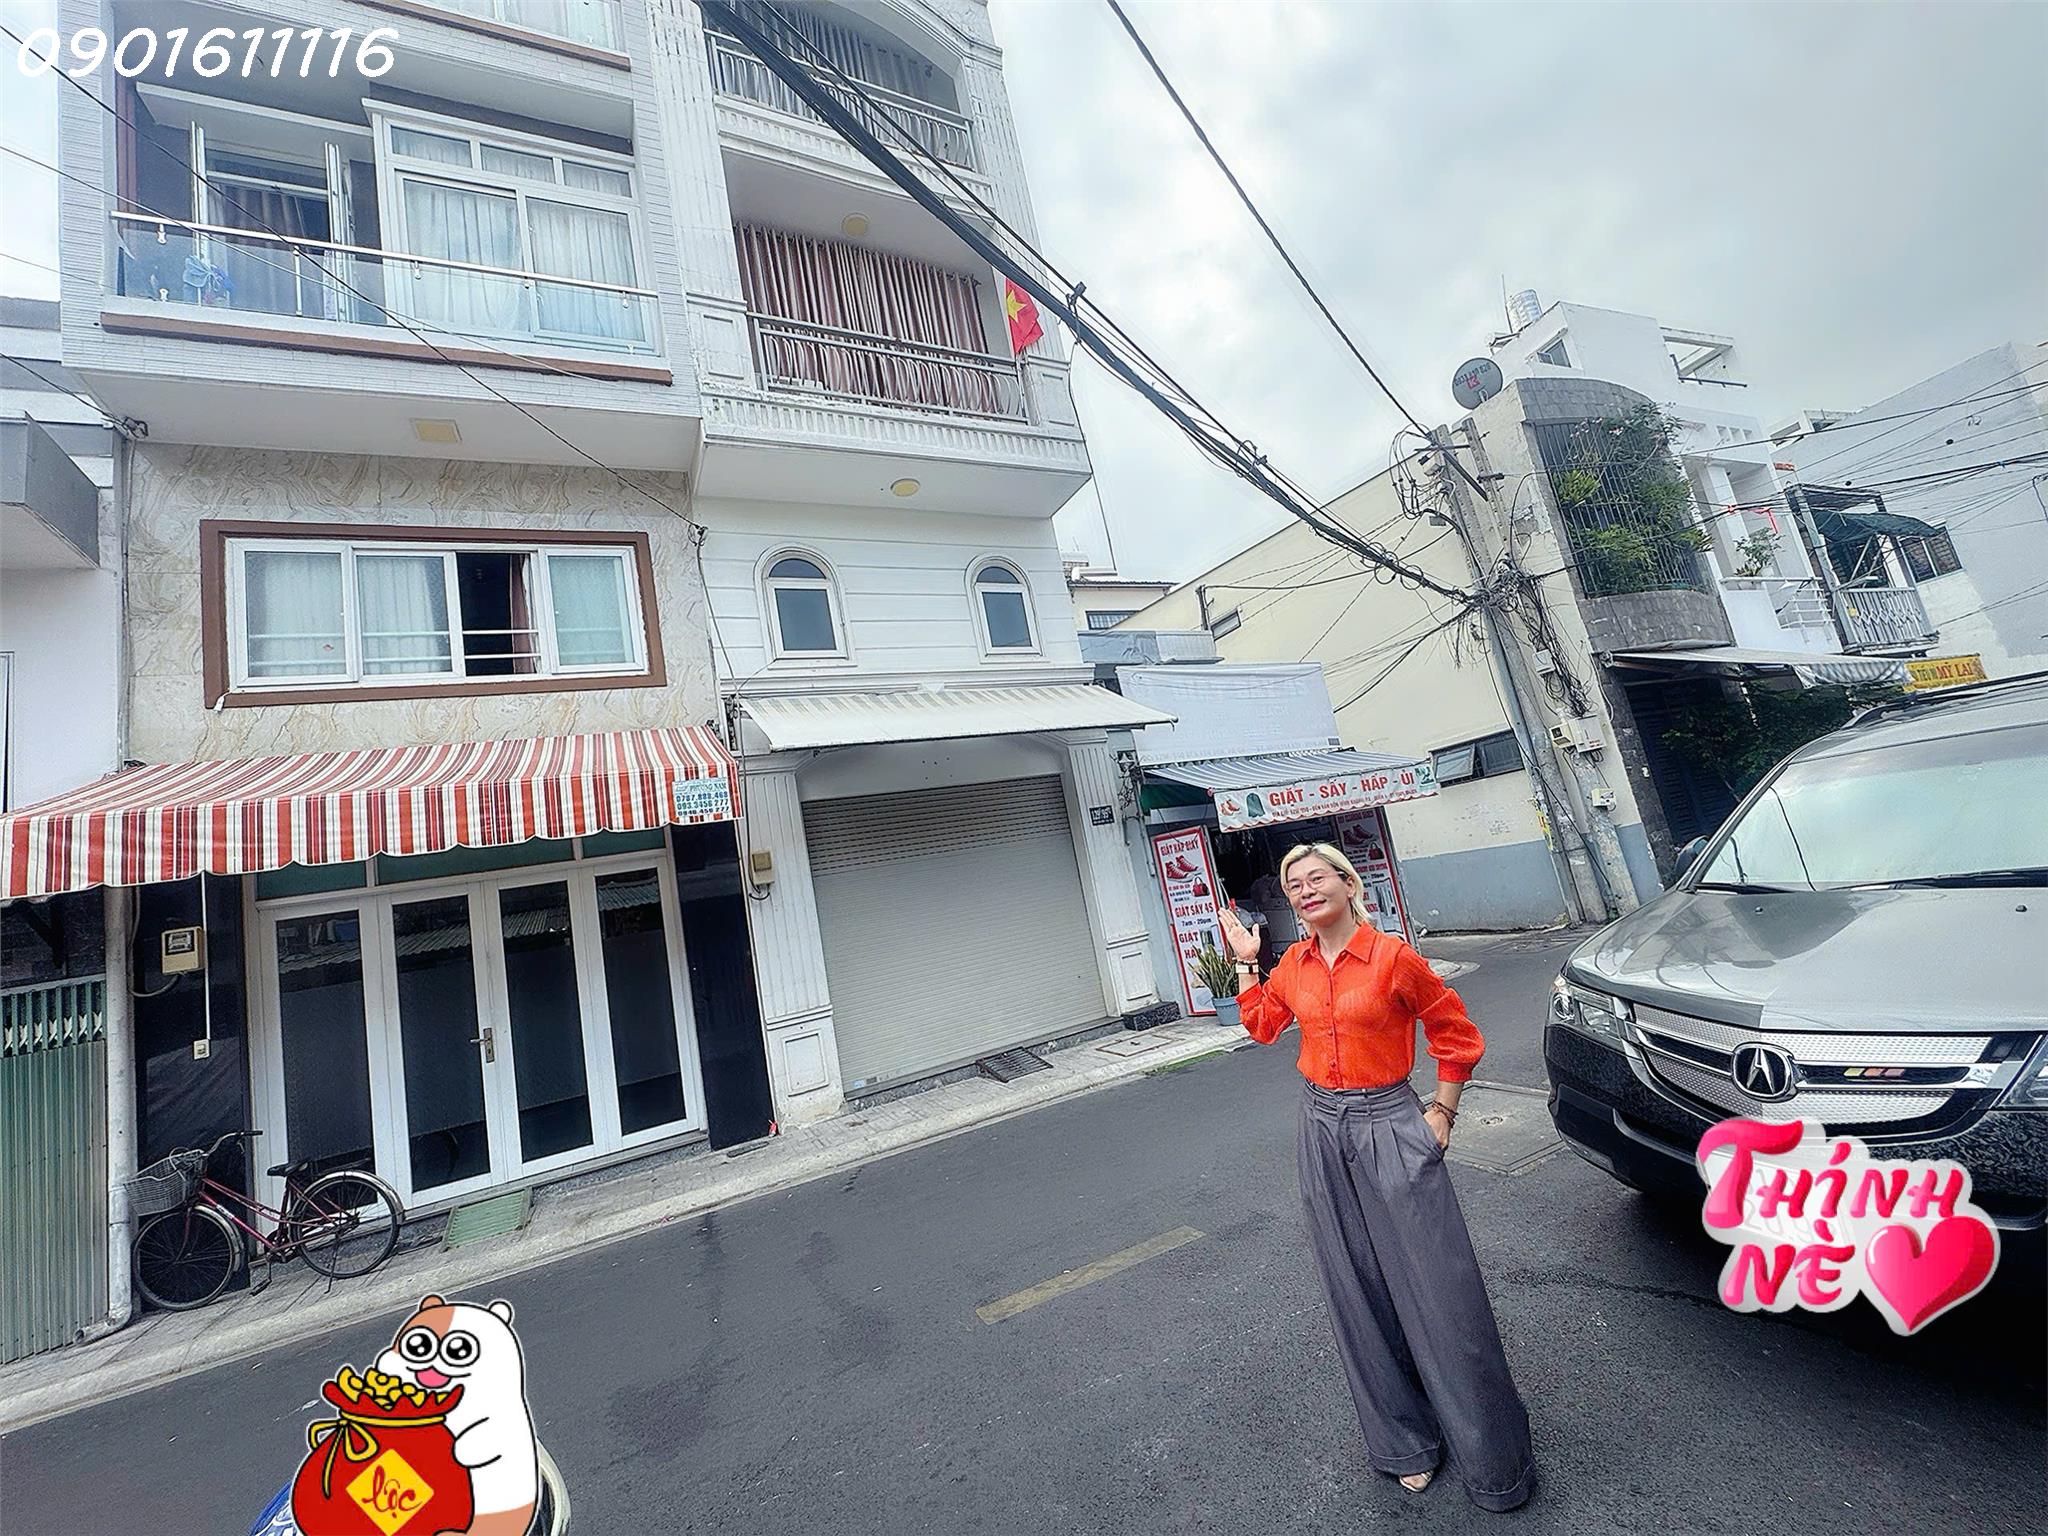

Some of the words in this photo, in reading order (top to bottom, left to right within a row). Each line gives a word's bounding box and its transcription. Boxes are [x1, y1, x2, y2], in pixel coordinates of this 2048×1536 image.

[1269, 788, 1304, 807] GIẶT
[1319, 779, 1347, 799] SẤY
[1361, 773, 1388, 792] HẤP
[1401, 769, 1416, 786] ỦI
